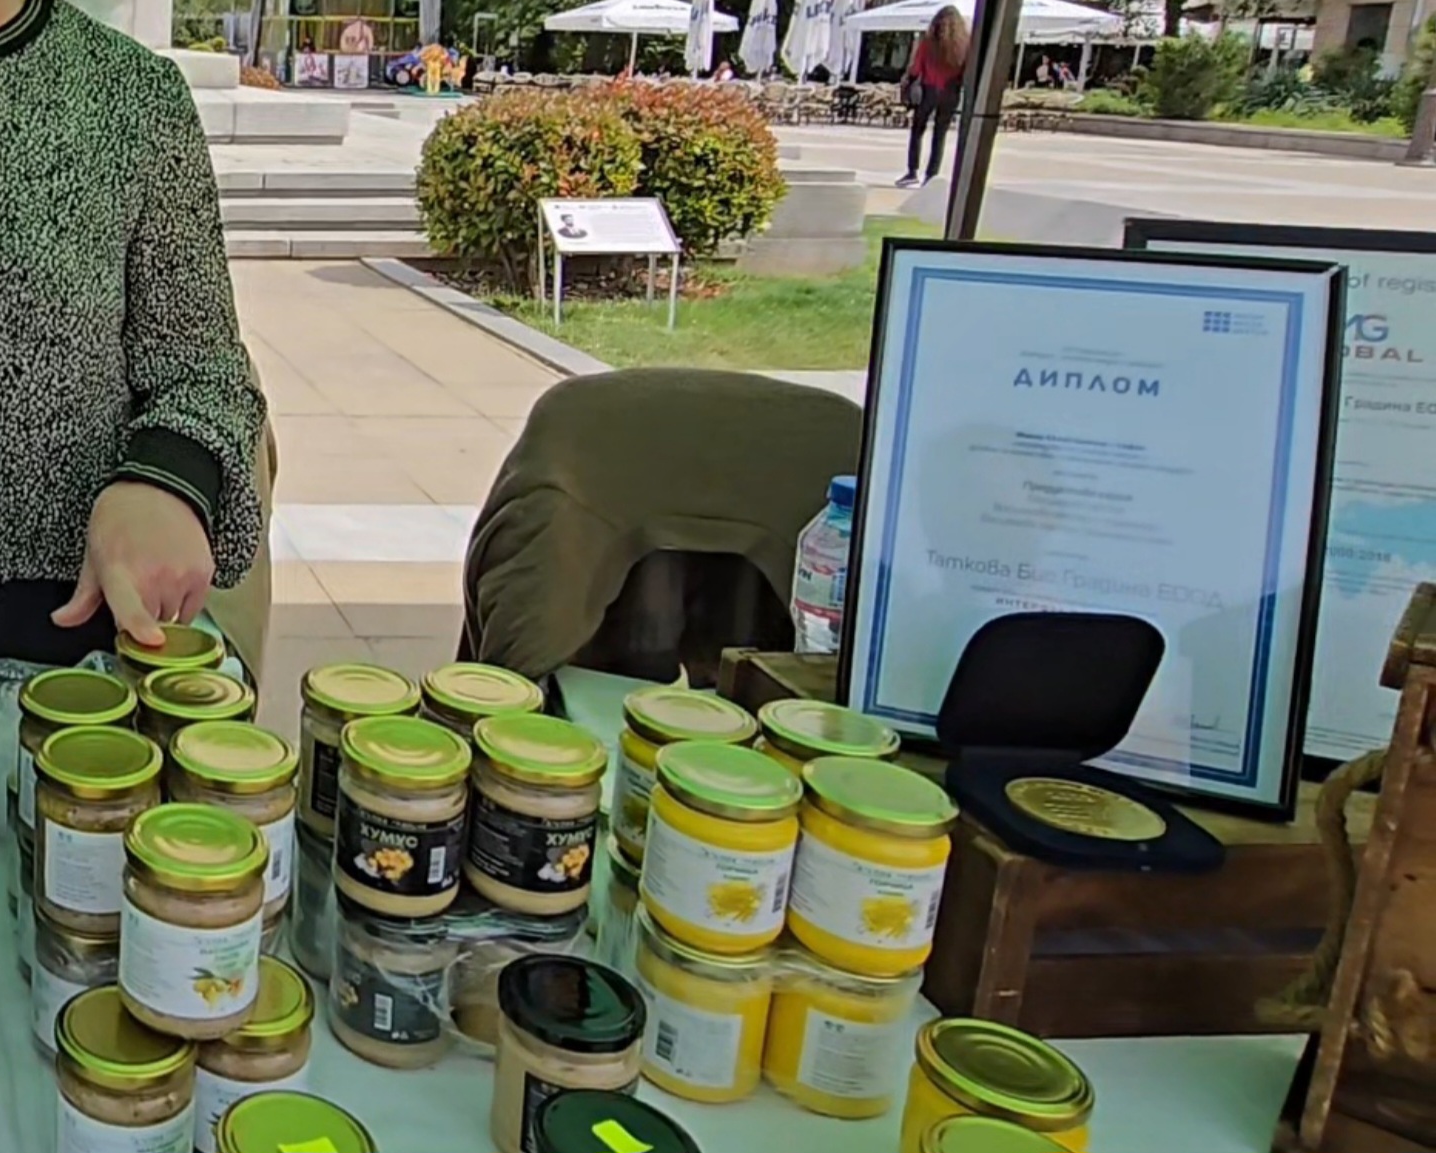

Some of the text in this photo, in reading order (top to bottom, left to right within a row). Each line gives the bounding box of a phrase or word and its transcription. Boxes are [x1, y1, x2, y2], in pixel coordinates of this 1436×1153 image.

[1014, 368, 1160, 397] ДИПЛОМ
[926, 549, 1011, 578] Таткова
[360, 823, 418, 849] ХУМУС
